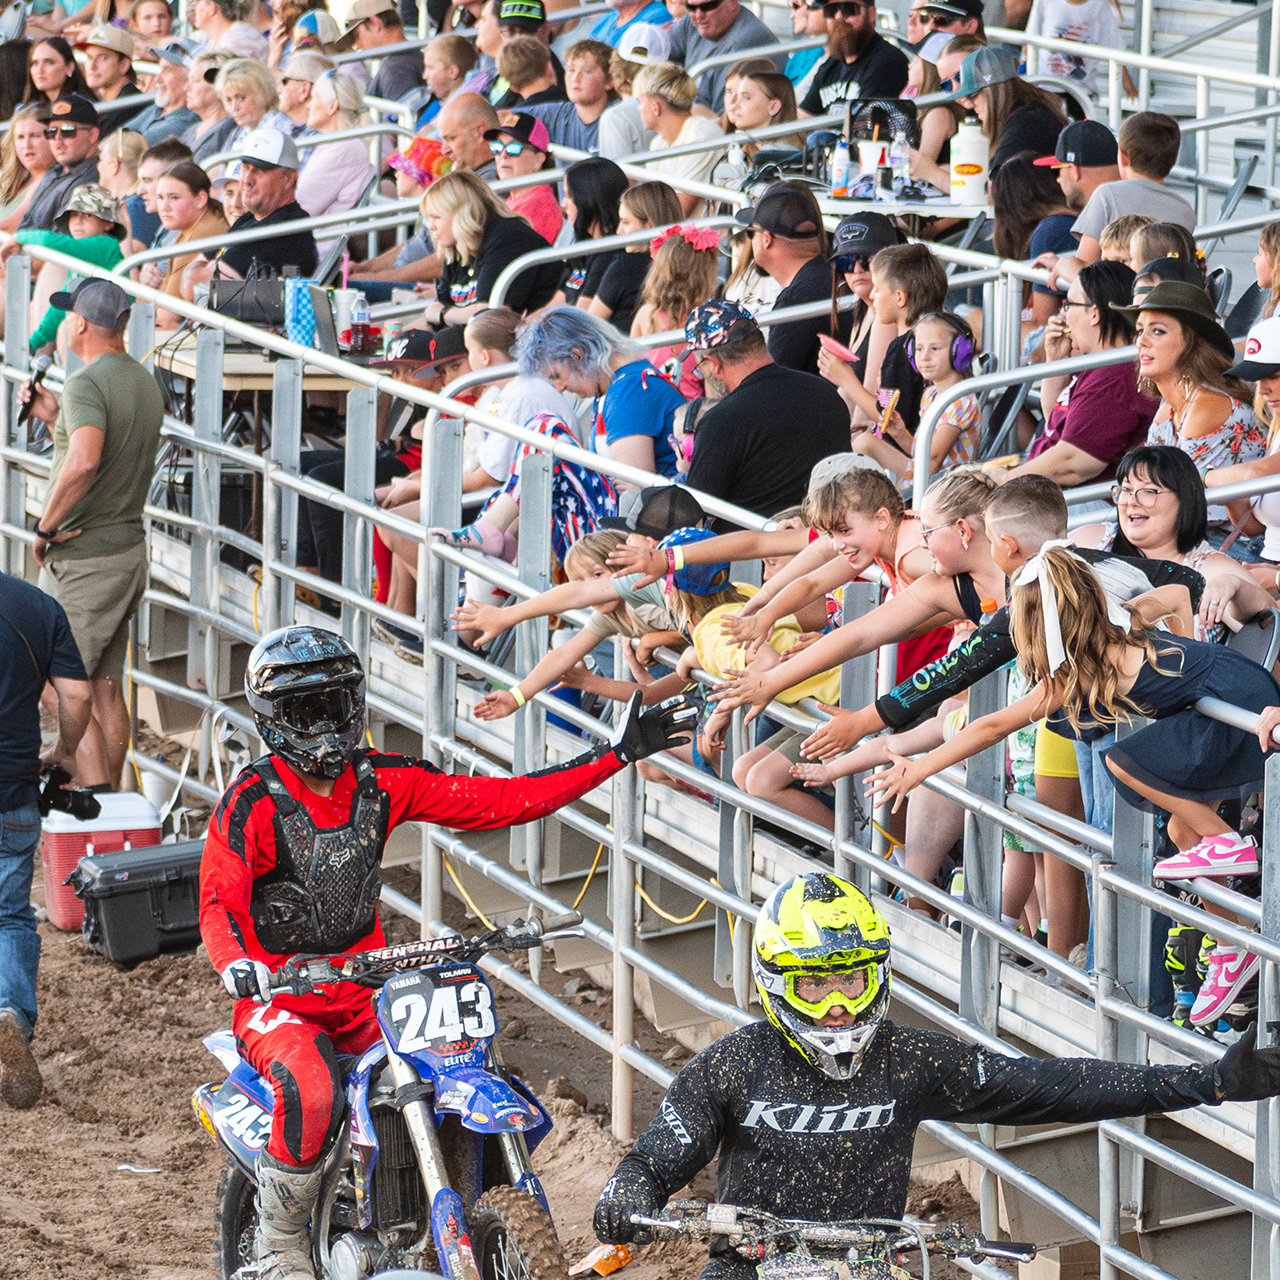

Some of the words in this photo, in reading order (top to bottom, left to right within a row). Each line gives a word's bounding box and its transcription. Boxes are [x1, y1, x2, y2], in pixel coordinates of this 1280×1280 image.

[367, 938, 461, 962] RENTHAL
[390, 976, 421, 990] YAMAHA
[439, 968, 472, 979] TOLMAN
[391, 982, 496, 1055] 243
[444, 1053, 471, 1067] ELITE
[740, 1099, 896, 1133] Klim
